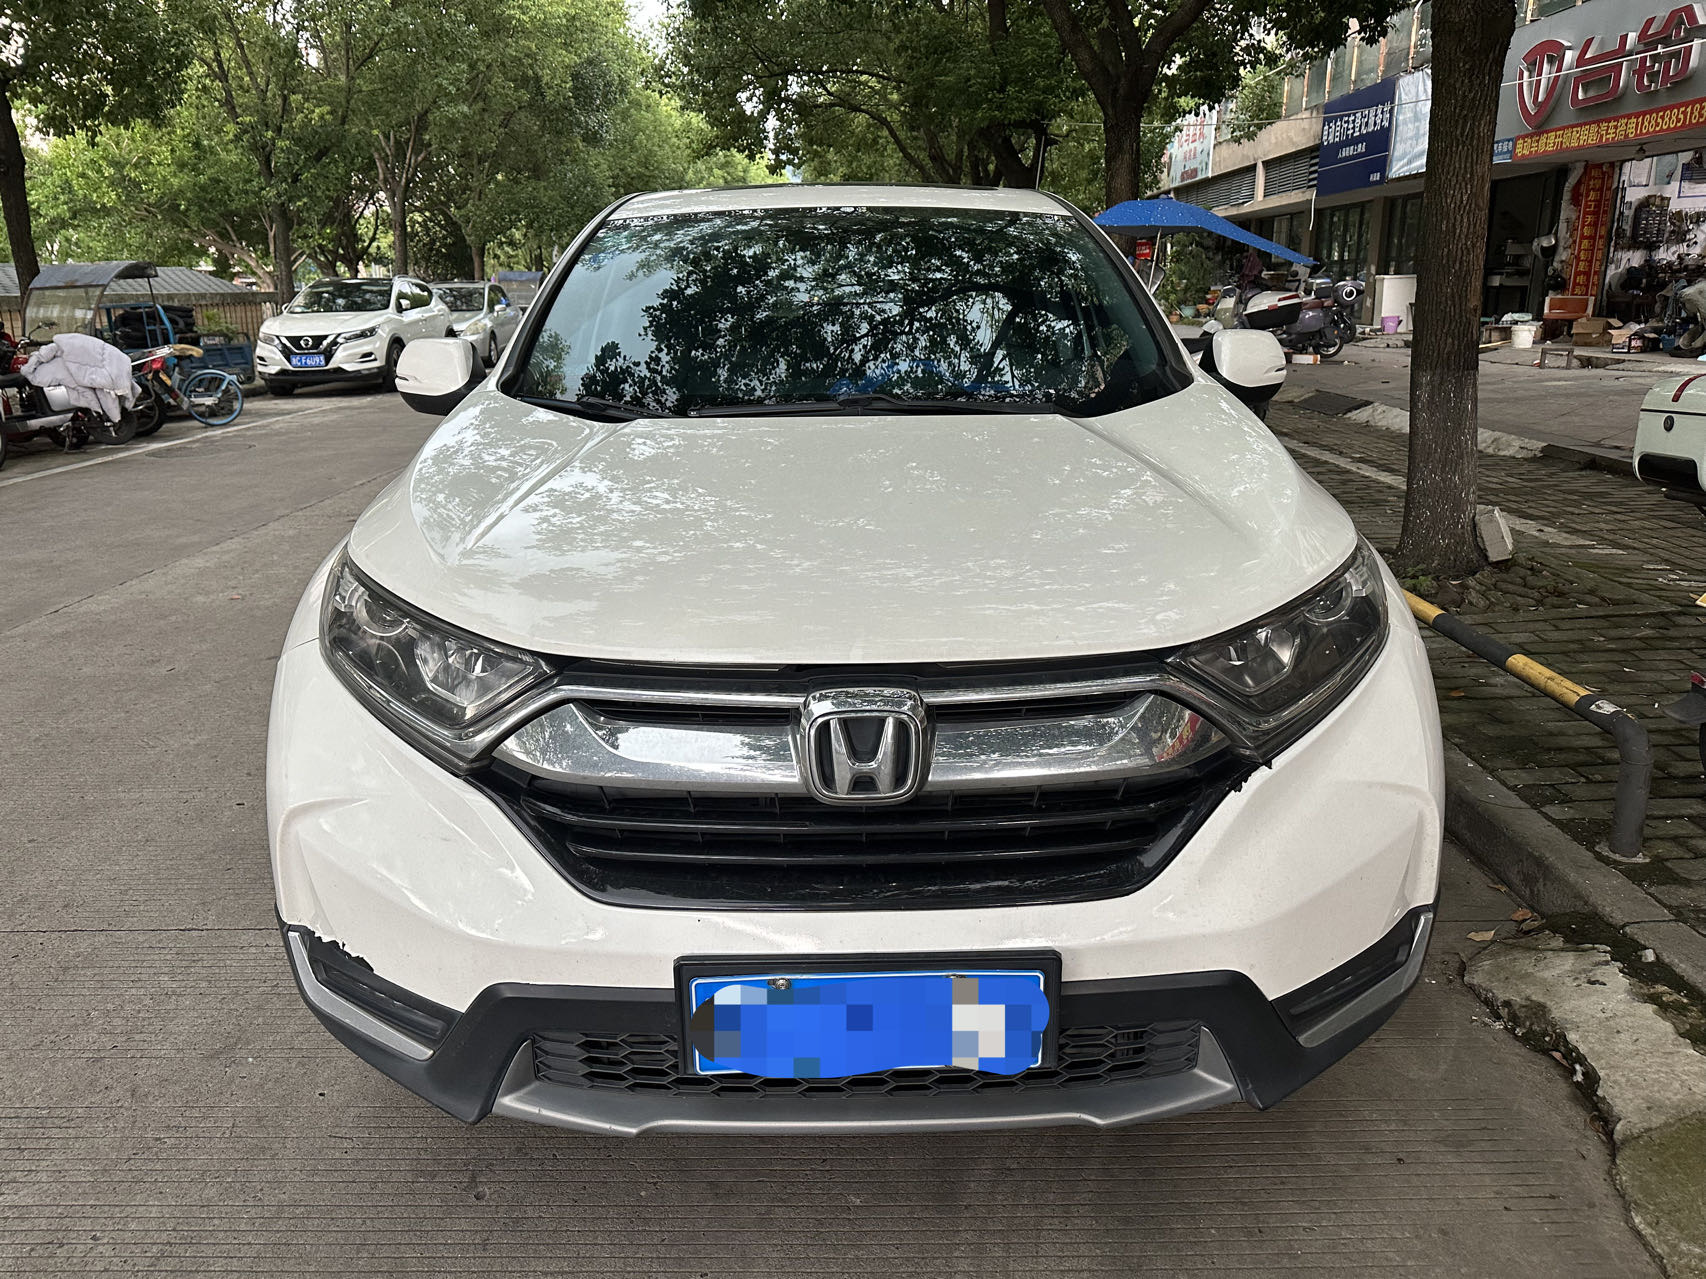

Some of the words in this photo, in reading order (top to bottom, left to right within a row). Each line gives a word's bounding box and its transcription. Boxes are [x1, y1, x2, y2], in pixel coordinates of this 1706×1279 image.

[1322, 101, 1391, 146] 电动自行车登记服务站
